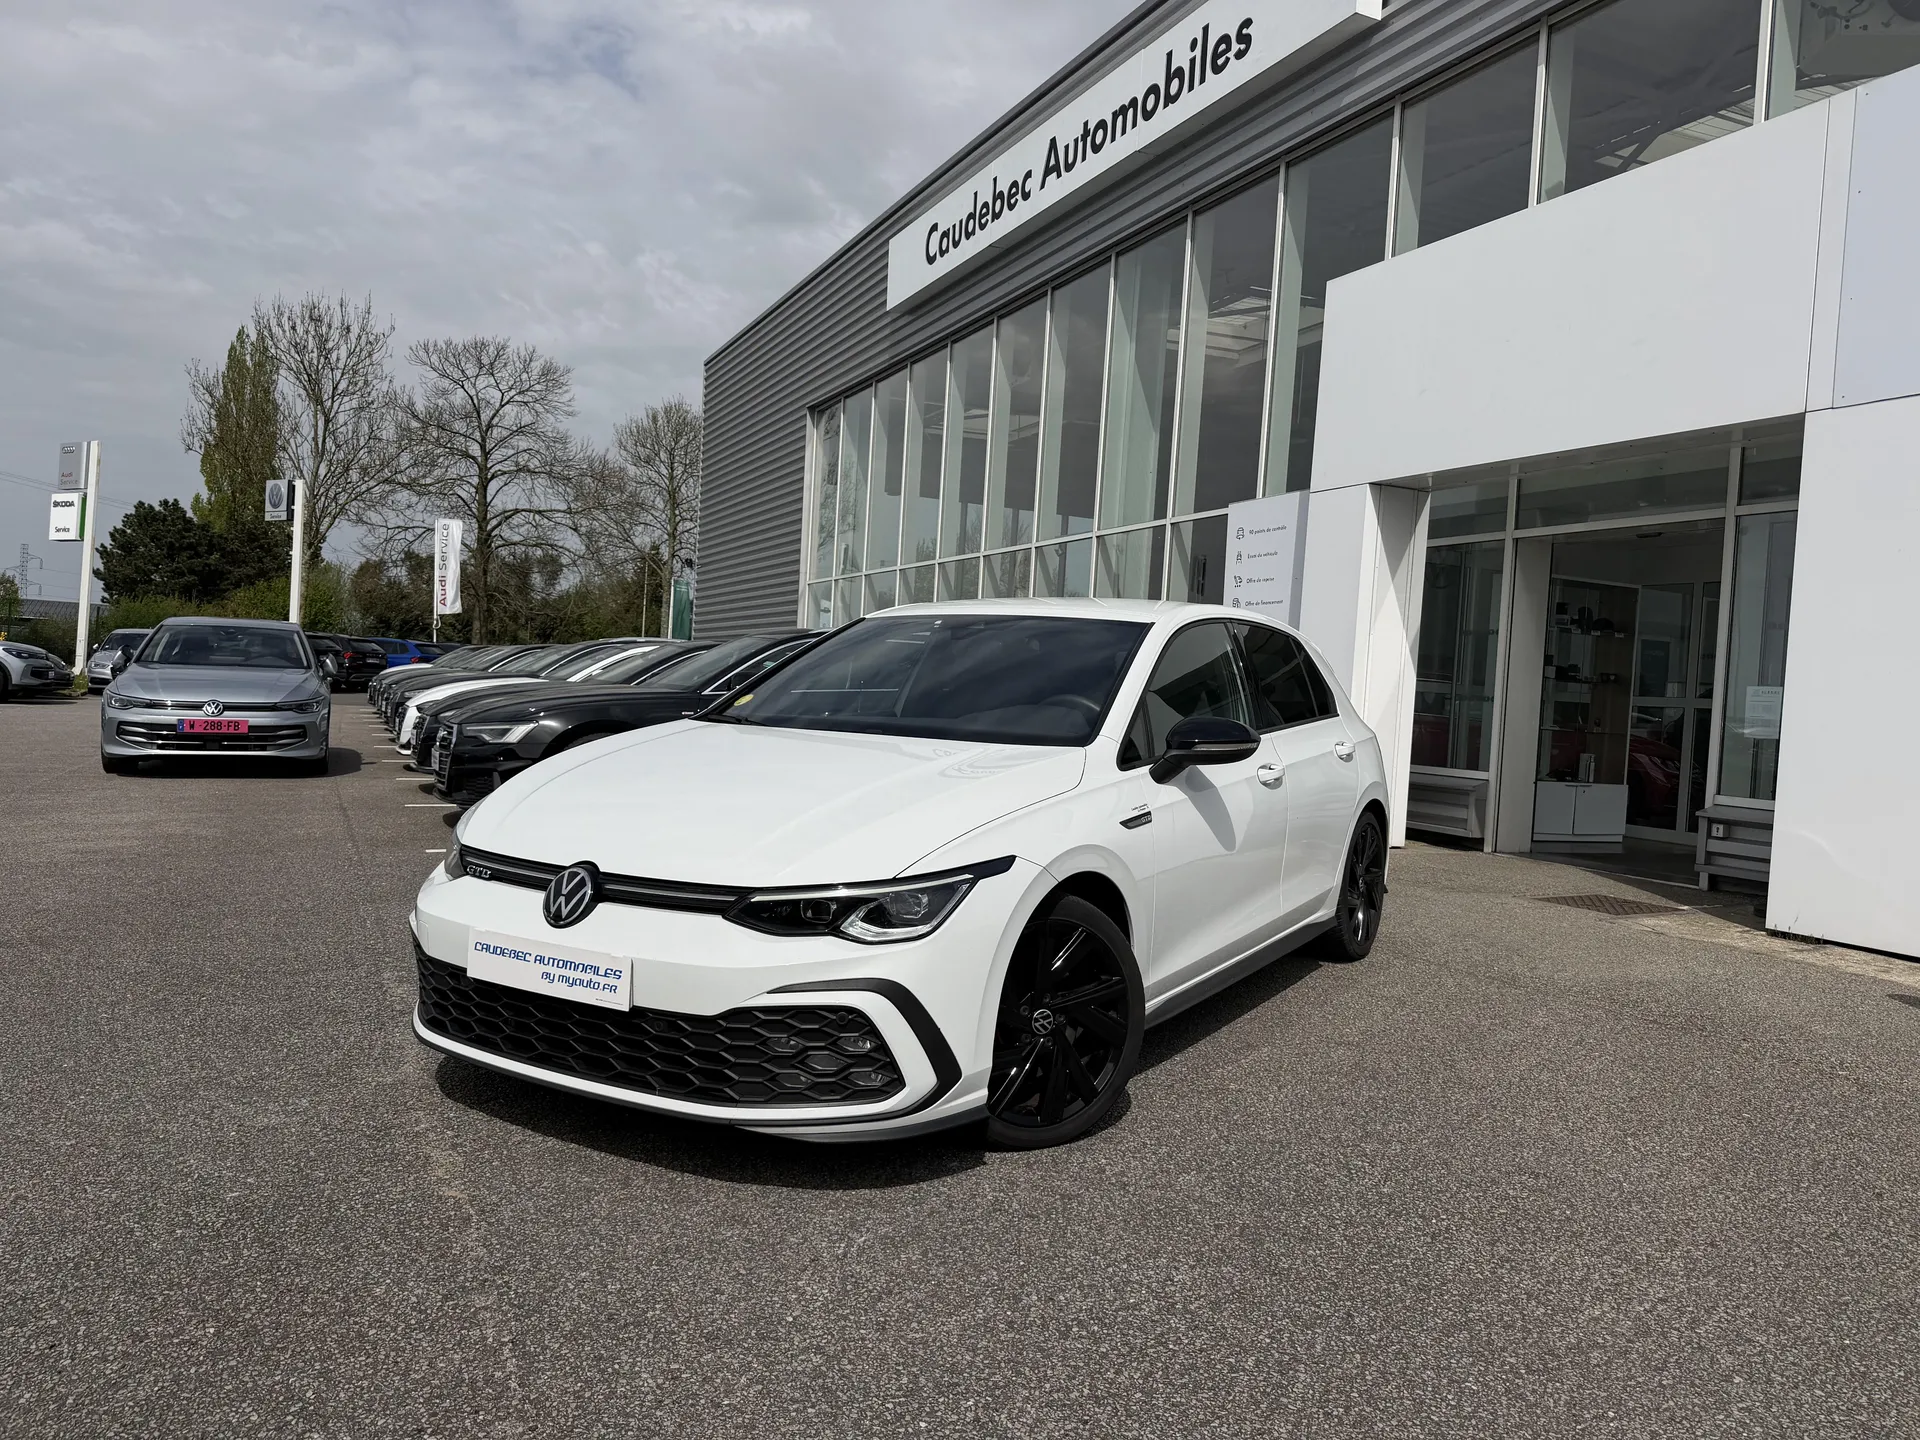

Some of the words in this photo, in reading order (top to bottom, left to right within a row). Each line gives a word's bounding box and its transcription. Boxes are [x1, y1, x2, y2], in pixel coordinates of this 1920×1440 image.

[924, 168, 1033, 266] Caudebec
[1038, 16, 1254, 192] Automobiles
[439, 523, 450, 571] Service
[438, 575, 447, 607] Audi
[466, 864, 492, 878] GTD
[474, 941, 532, 963] CAUDEBEC
[533, 954, 623, 980] AUTOMOBILES
